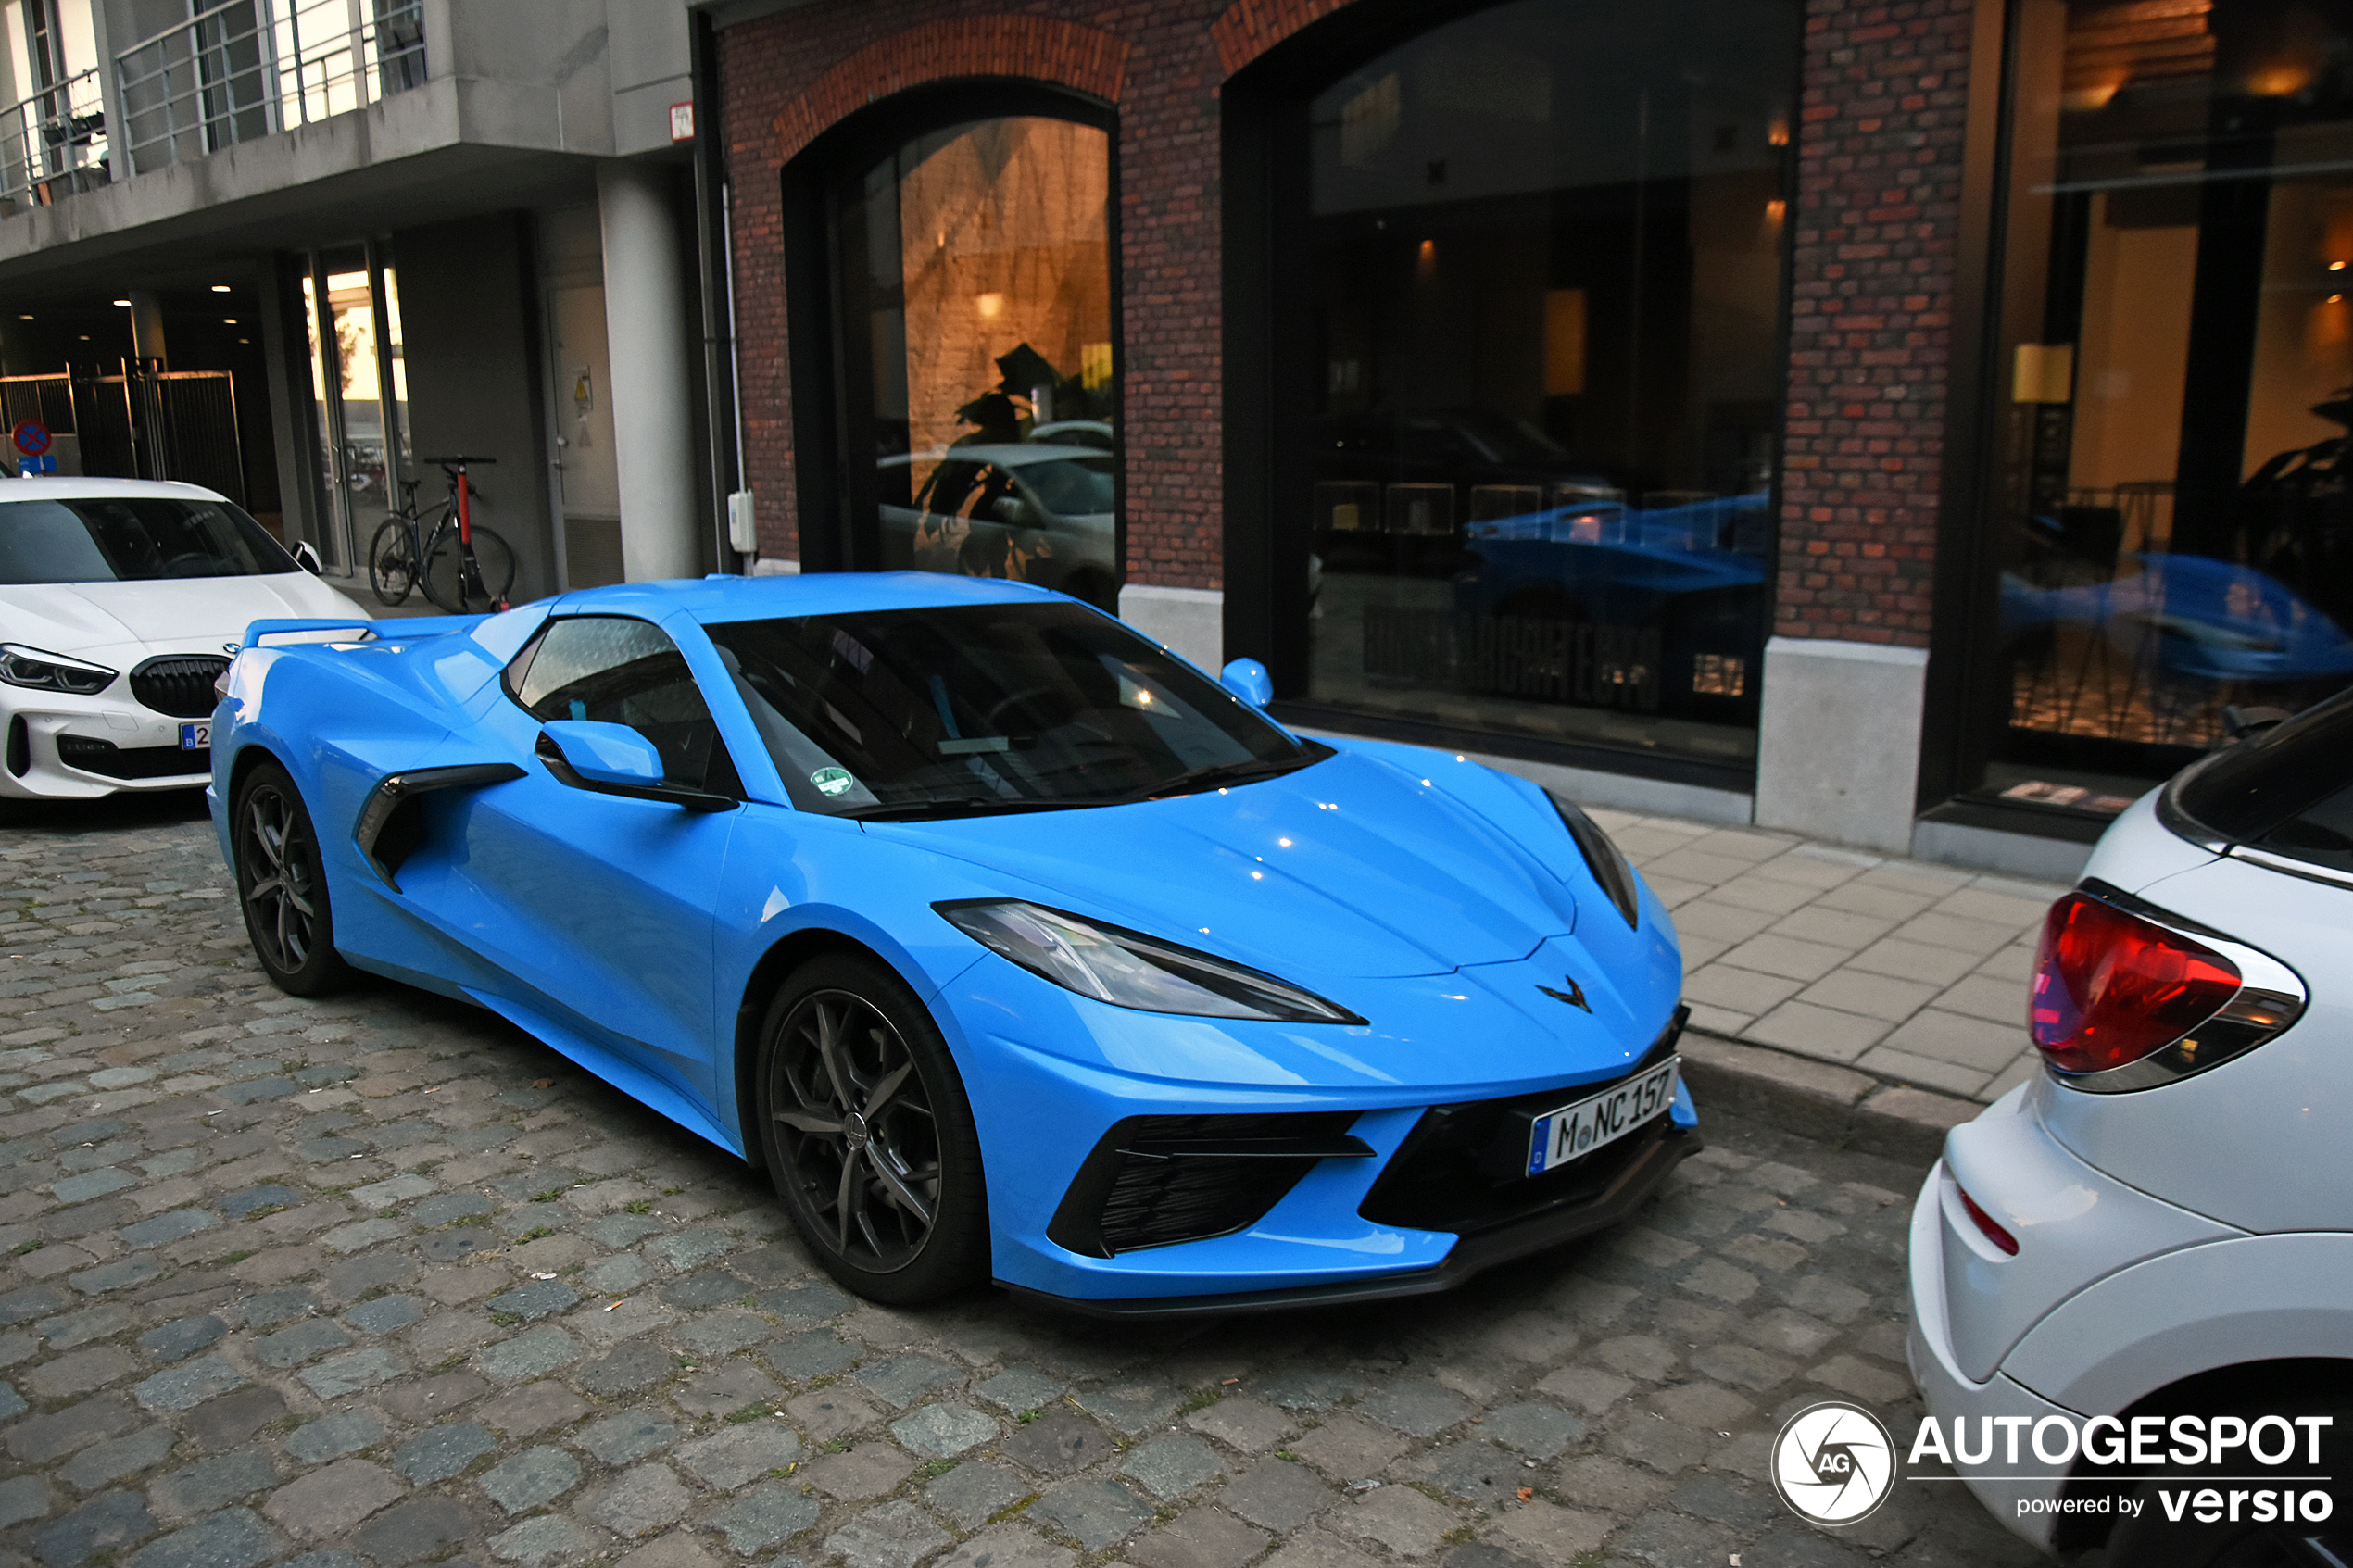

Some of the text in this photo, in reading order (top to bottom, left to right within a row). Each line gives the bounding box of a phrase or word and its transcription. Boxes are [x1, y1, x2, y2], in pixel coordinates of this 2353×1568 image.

[185, 738, 194, 746] B
[196, 727, 209, 745] 2
[1556, 1068, 1671, 1159] M NC 157
[1534, 1151, 1542, 1164] D
